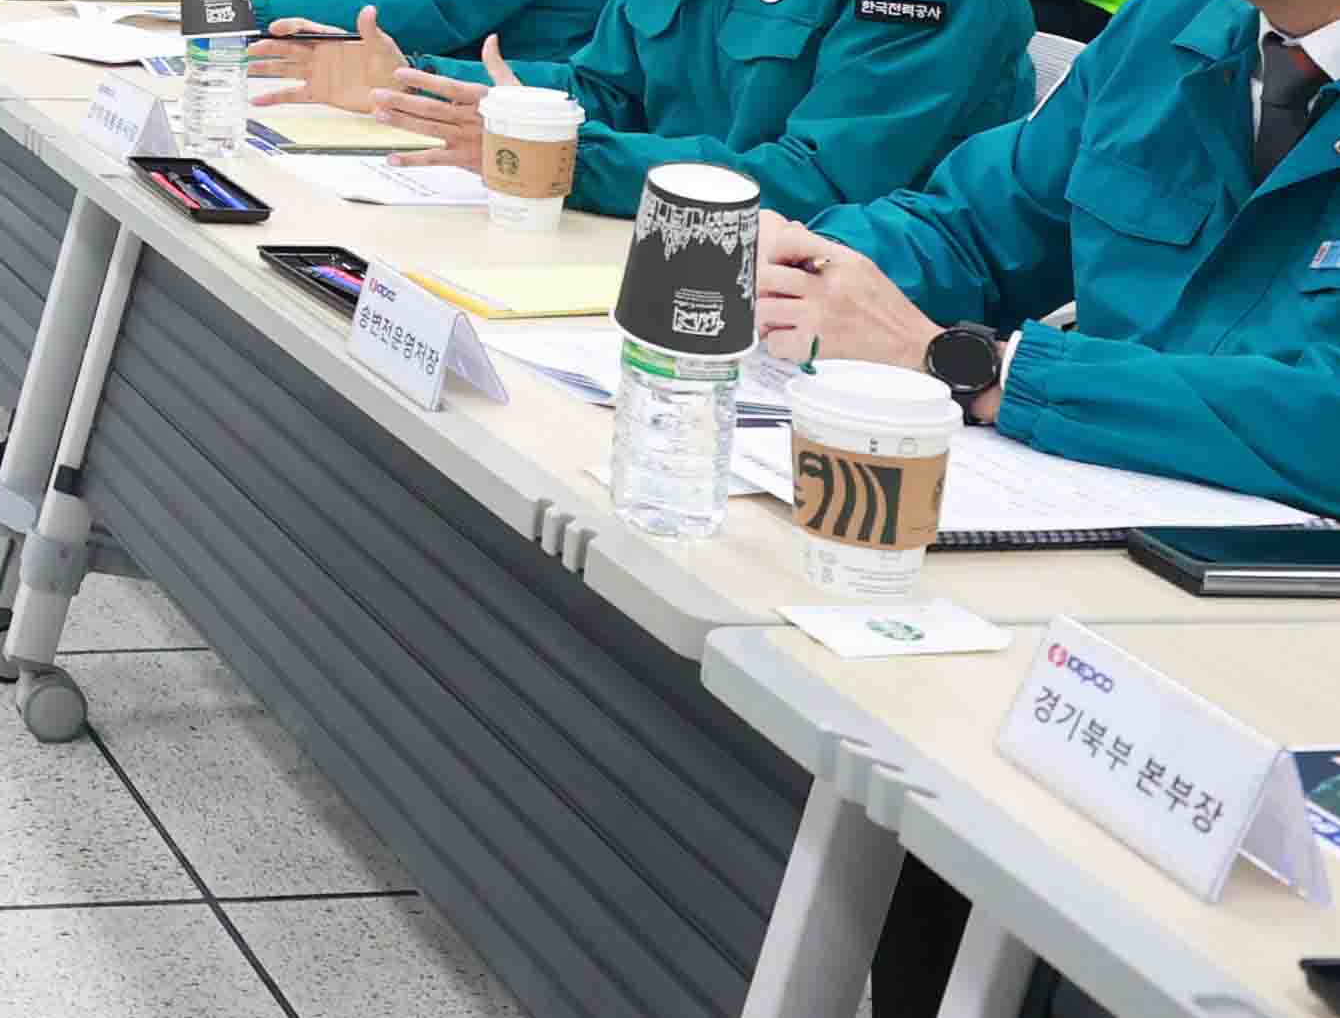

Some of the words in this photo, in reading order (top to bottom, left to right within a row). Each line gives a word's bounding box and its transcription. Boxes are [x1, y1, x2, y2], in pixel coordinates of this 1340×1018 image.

[861, 0, 942, 21] 한국전력공사
[1034, 685, 1135, 772] 경기북부
[1135, 757, 1225, 835] 본부장
